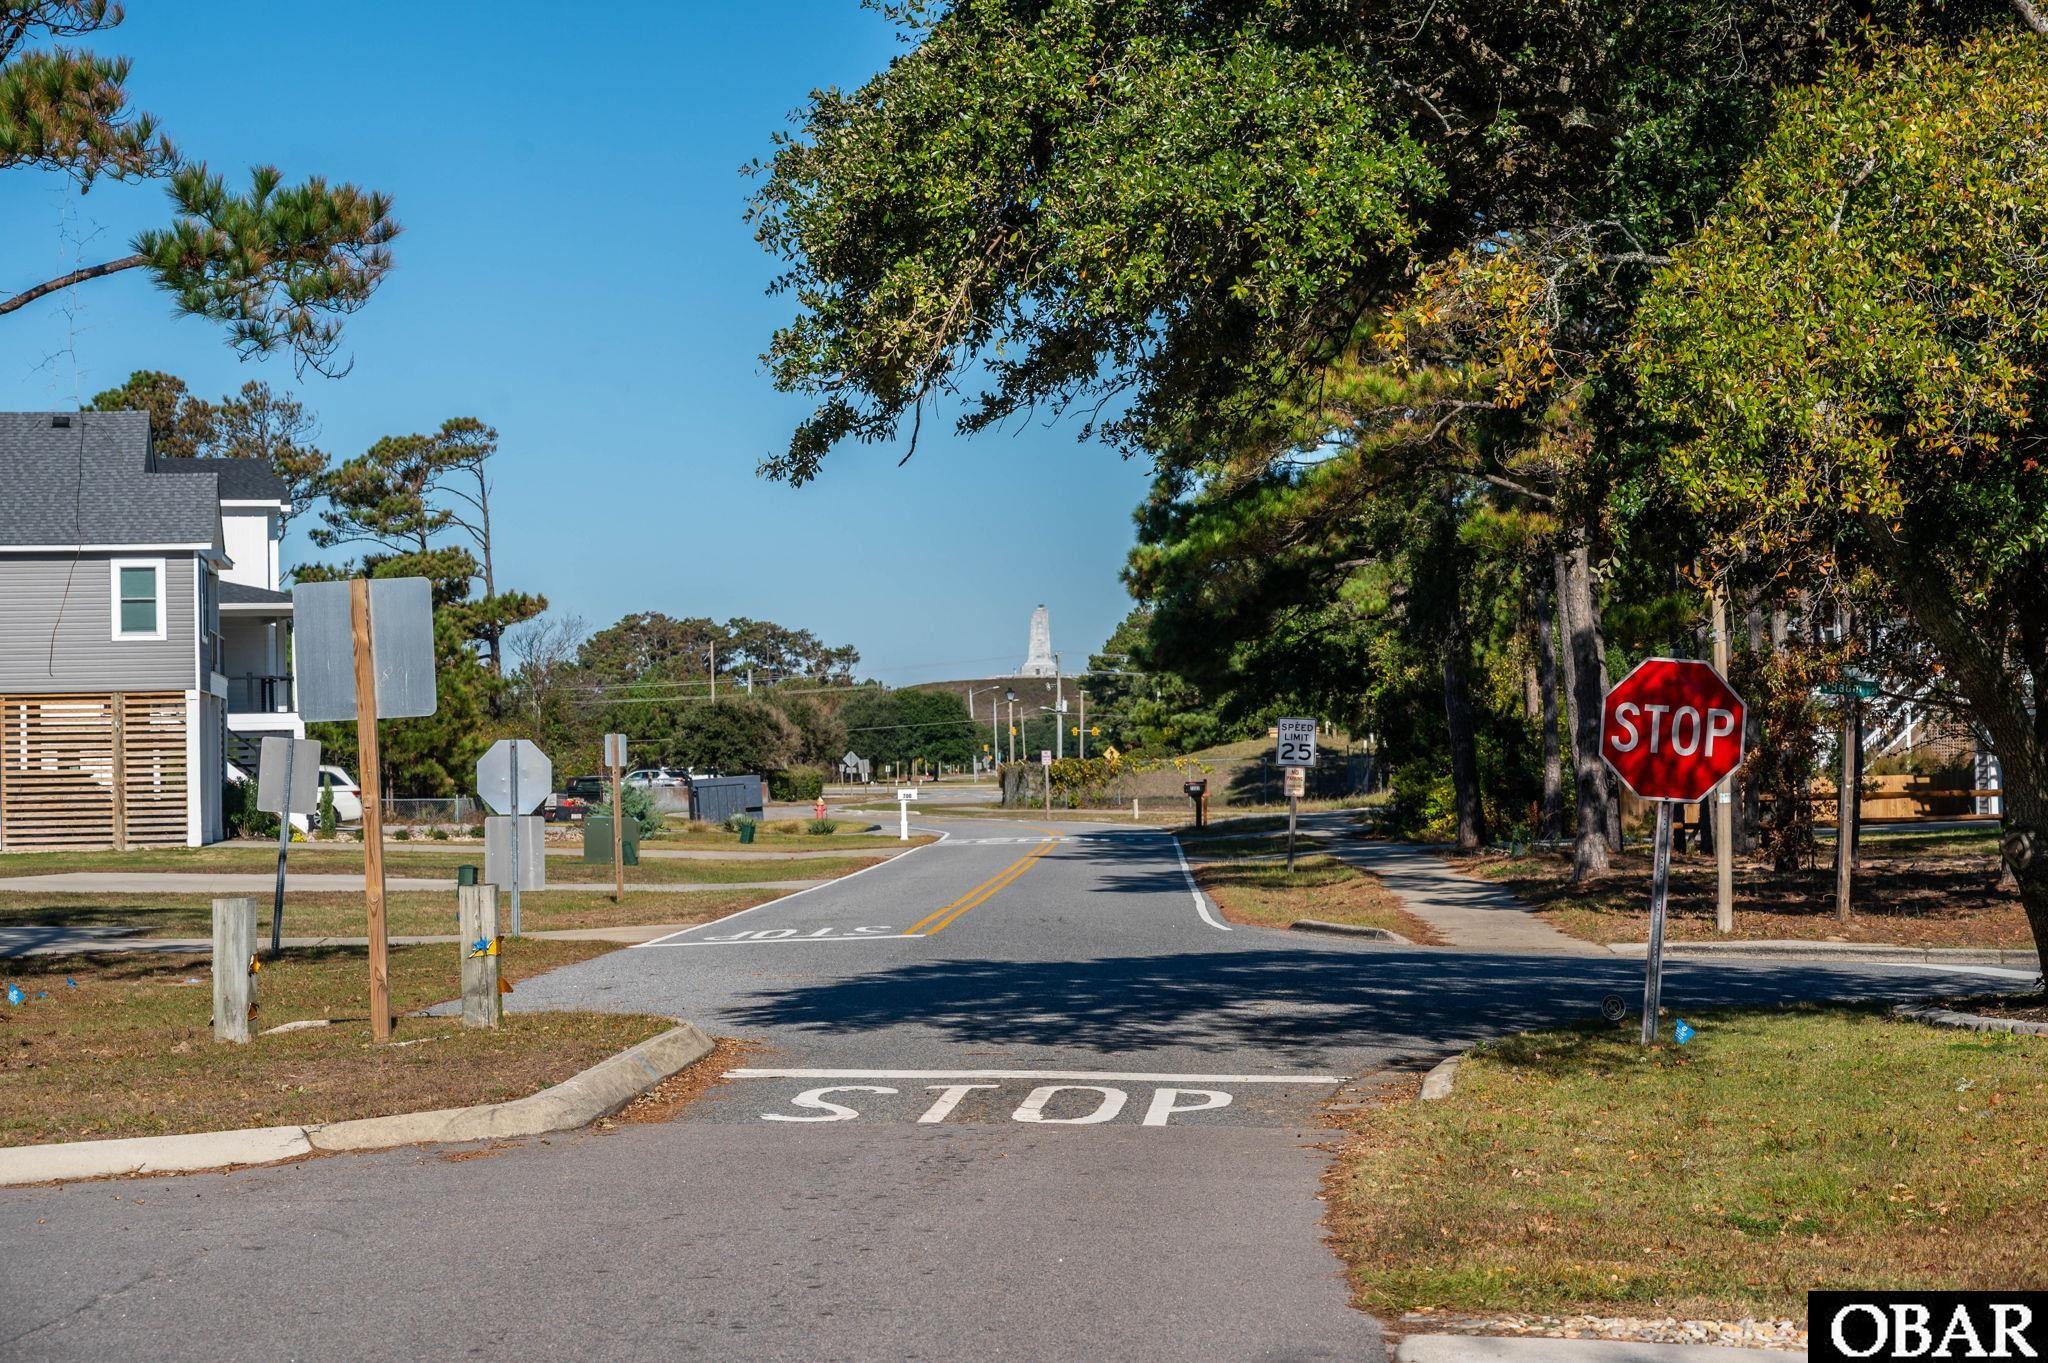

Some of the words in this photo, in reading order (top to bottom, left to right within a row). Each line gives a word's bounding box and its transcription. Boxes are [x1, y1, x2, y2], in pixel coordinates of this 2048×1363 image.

[1281, 723, 1314, 732] SPEED
[1611, 702, 1735, 757] STOP
[1285, 733, 1310, 741] LIMIT
[1281, 743, 1312, 760] 25
[704, 926, 892, 940] STOP
[760, 1084, 1233, 1126] STOP
